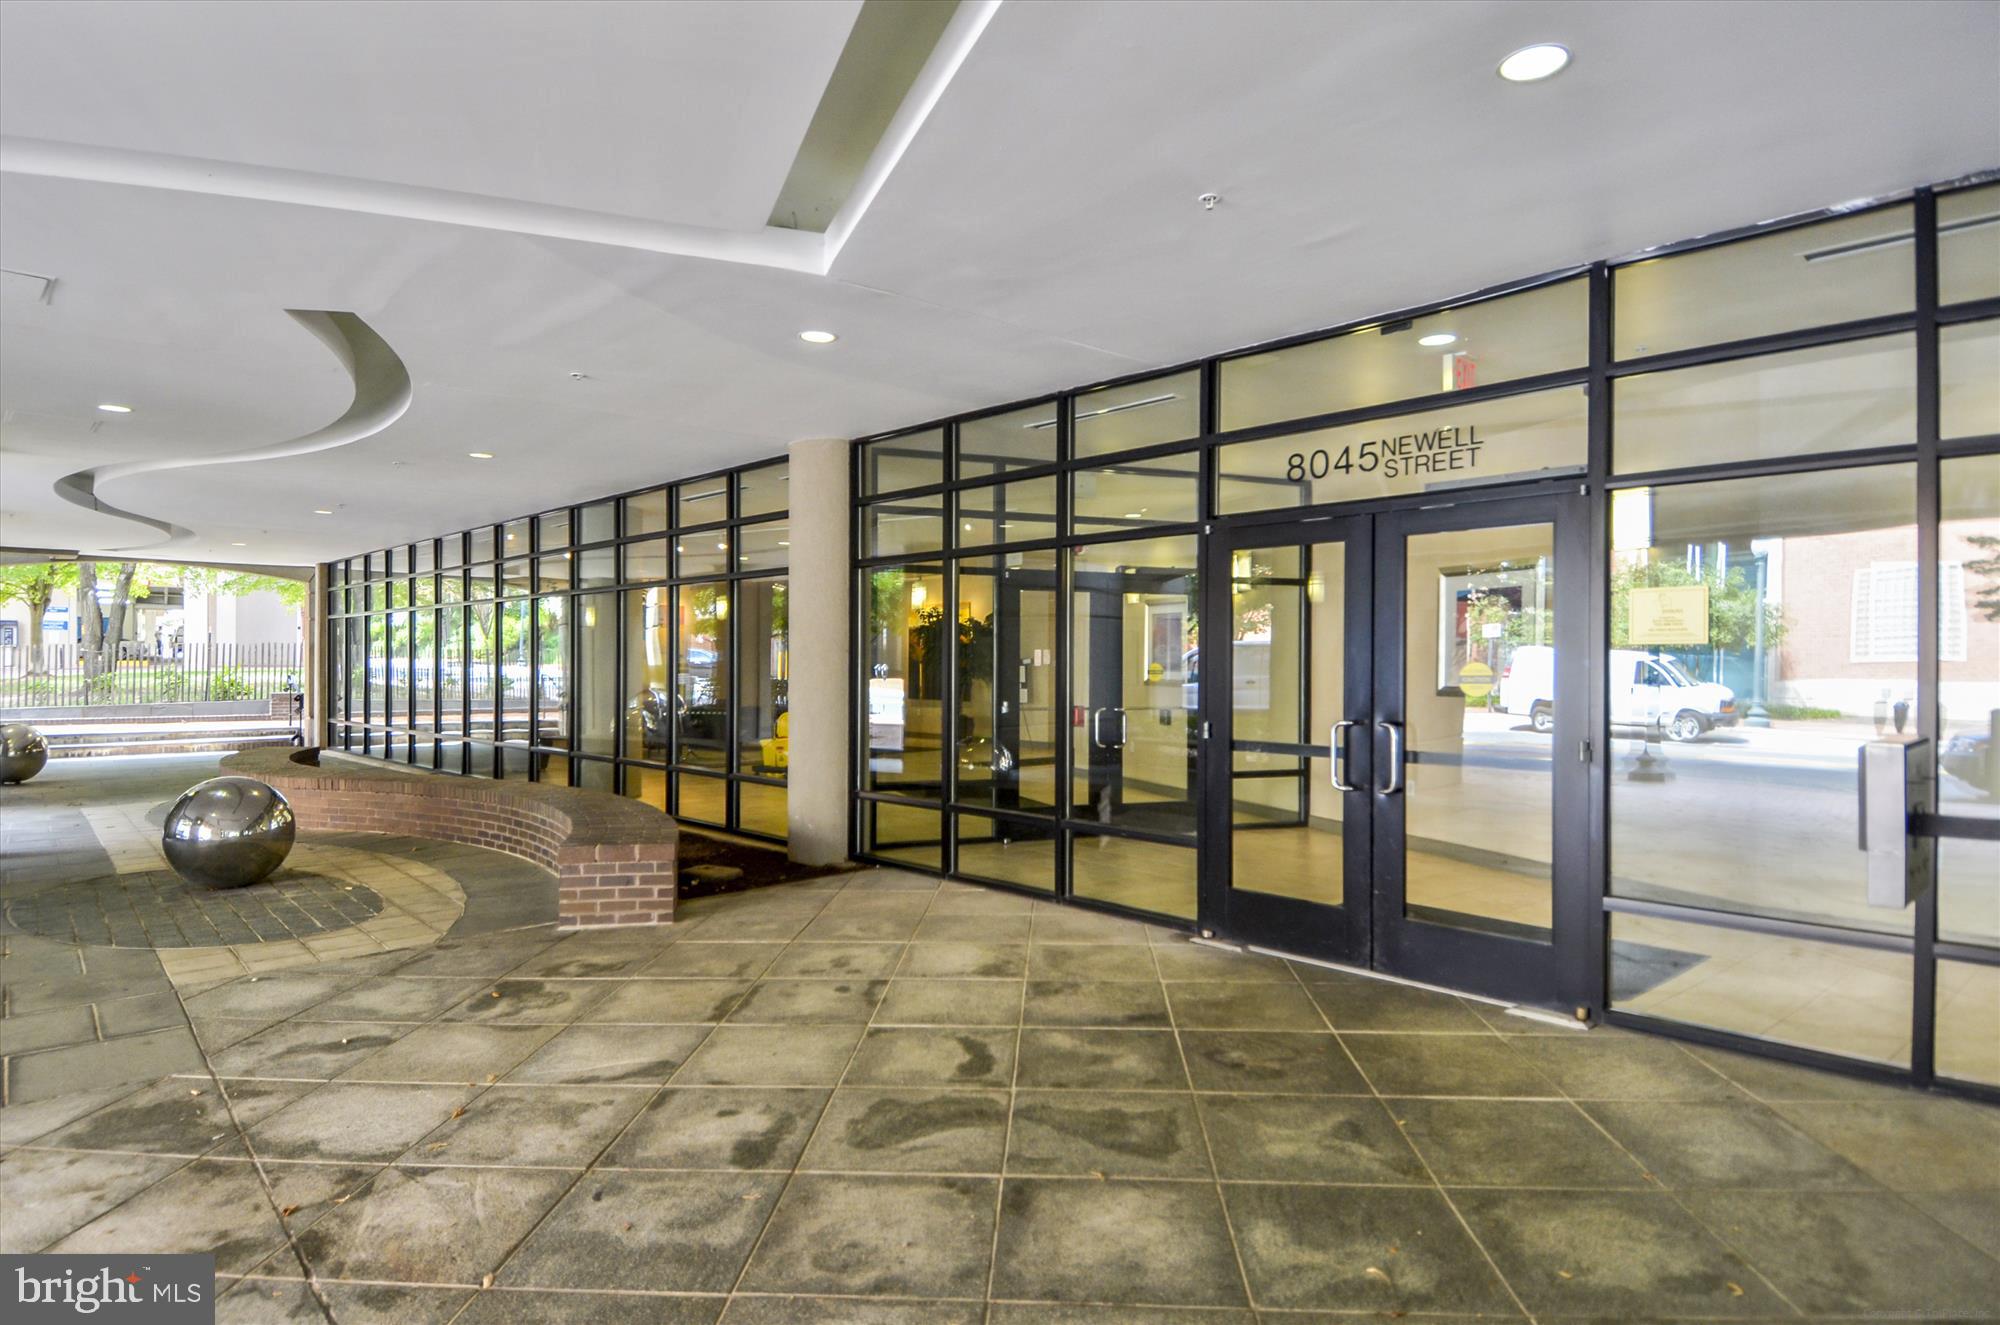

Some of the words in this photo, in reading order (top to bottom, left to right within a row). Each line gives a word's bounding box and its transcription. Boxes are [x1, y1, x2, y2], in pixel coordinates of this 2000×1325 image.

[1286, 441, 1380, 483] 8045
[1381, 425, 1484, 458] NEWELL
[1384, 447, 1481, 479] STREET
